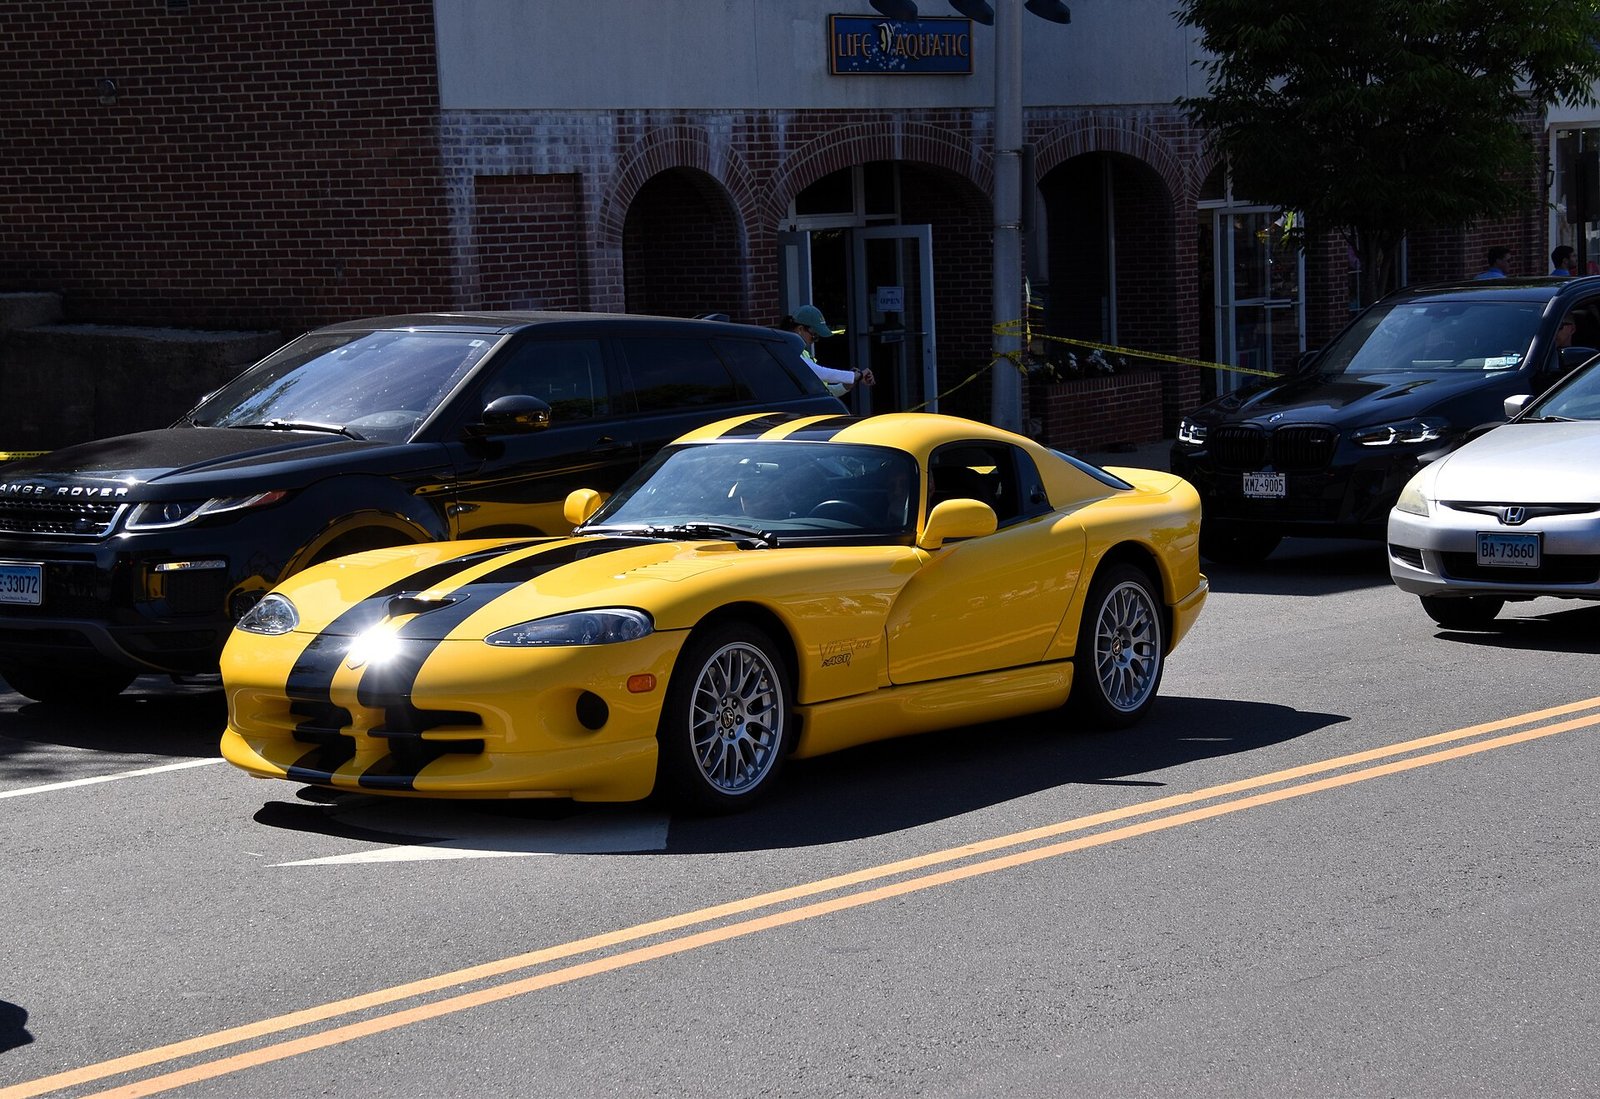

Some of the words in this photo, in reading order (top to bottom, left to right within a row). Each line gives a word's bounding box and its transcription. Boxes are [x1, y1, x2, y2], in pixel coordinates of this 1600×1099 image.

[837, 33, 872, 57] LIFE
[895, 33, 969, 60] AQUATIC
[880, 297, 901, 305] OPEN
[56, 486, 129, 497] ROVER
